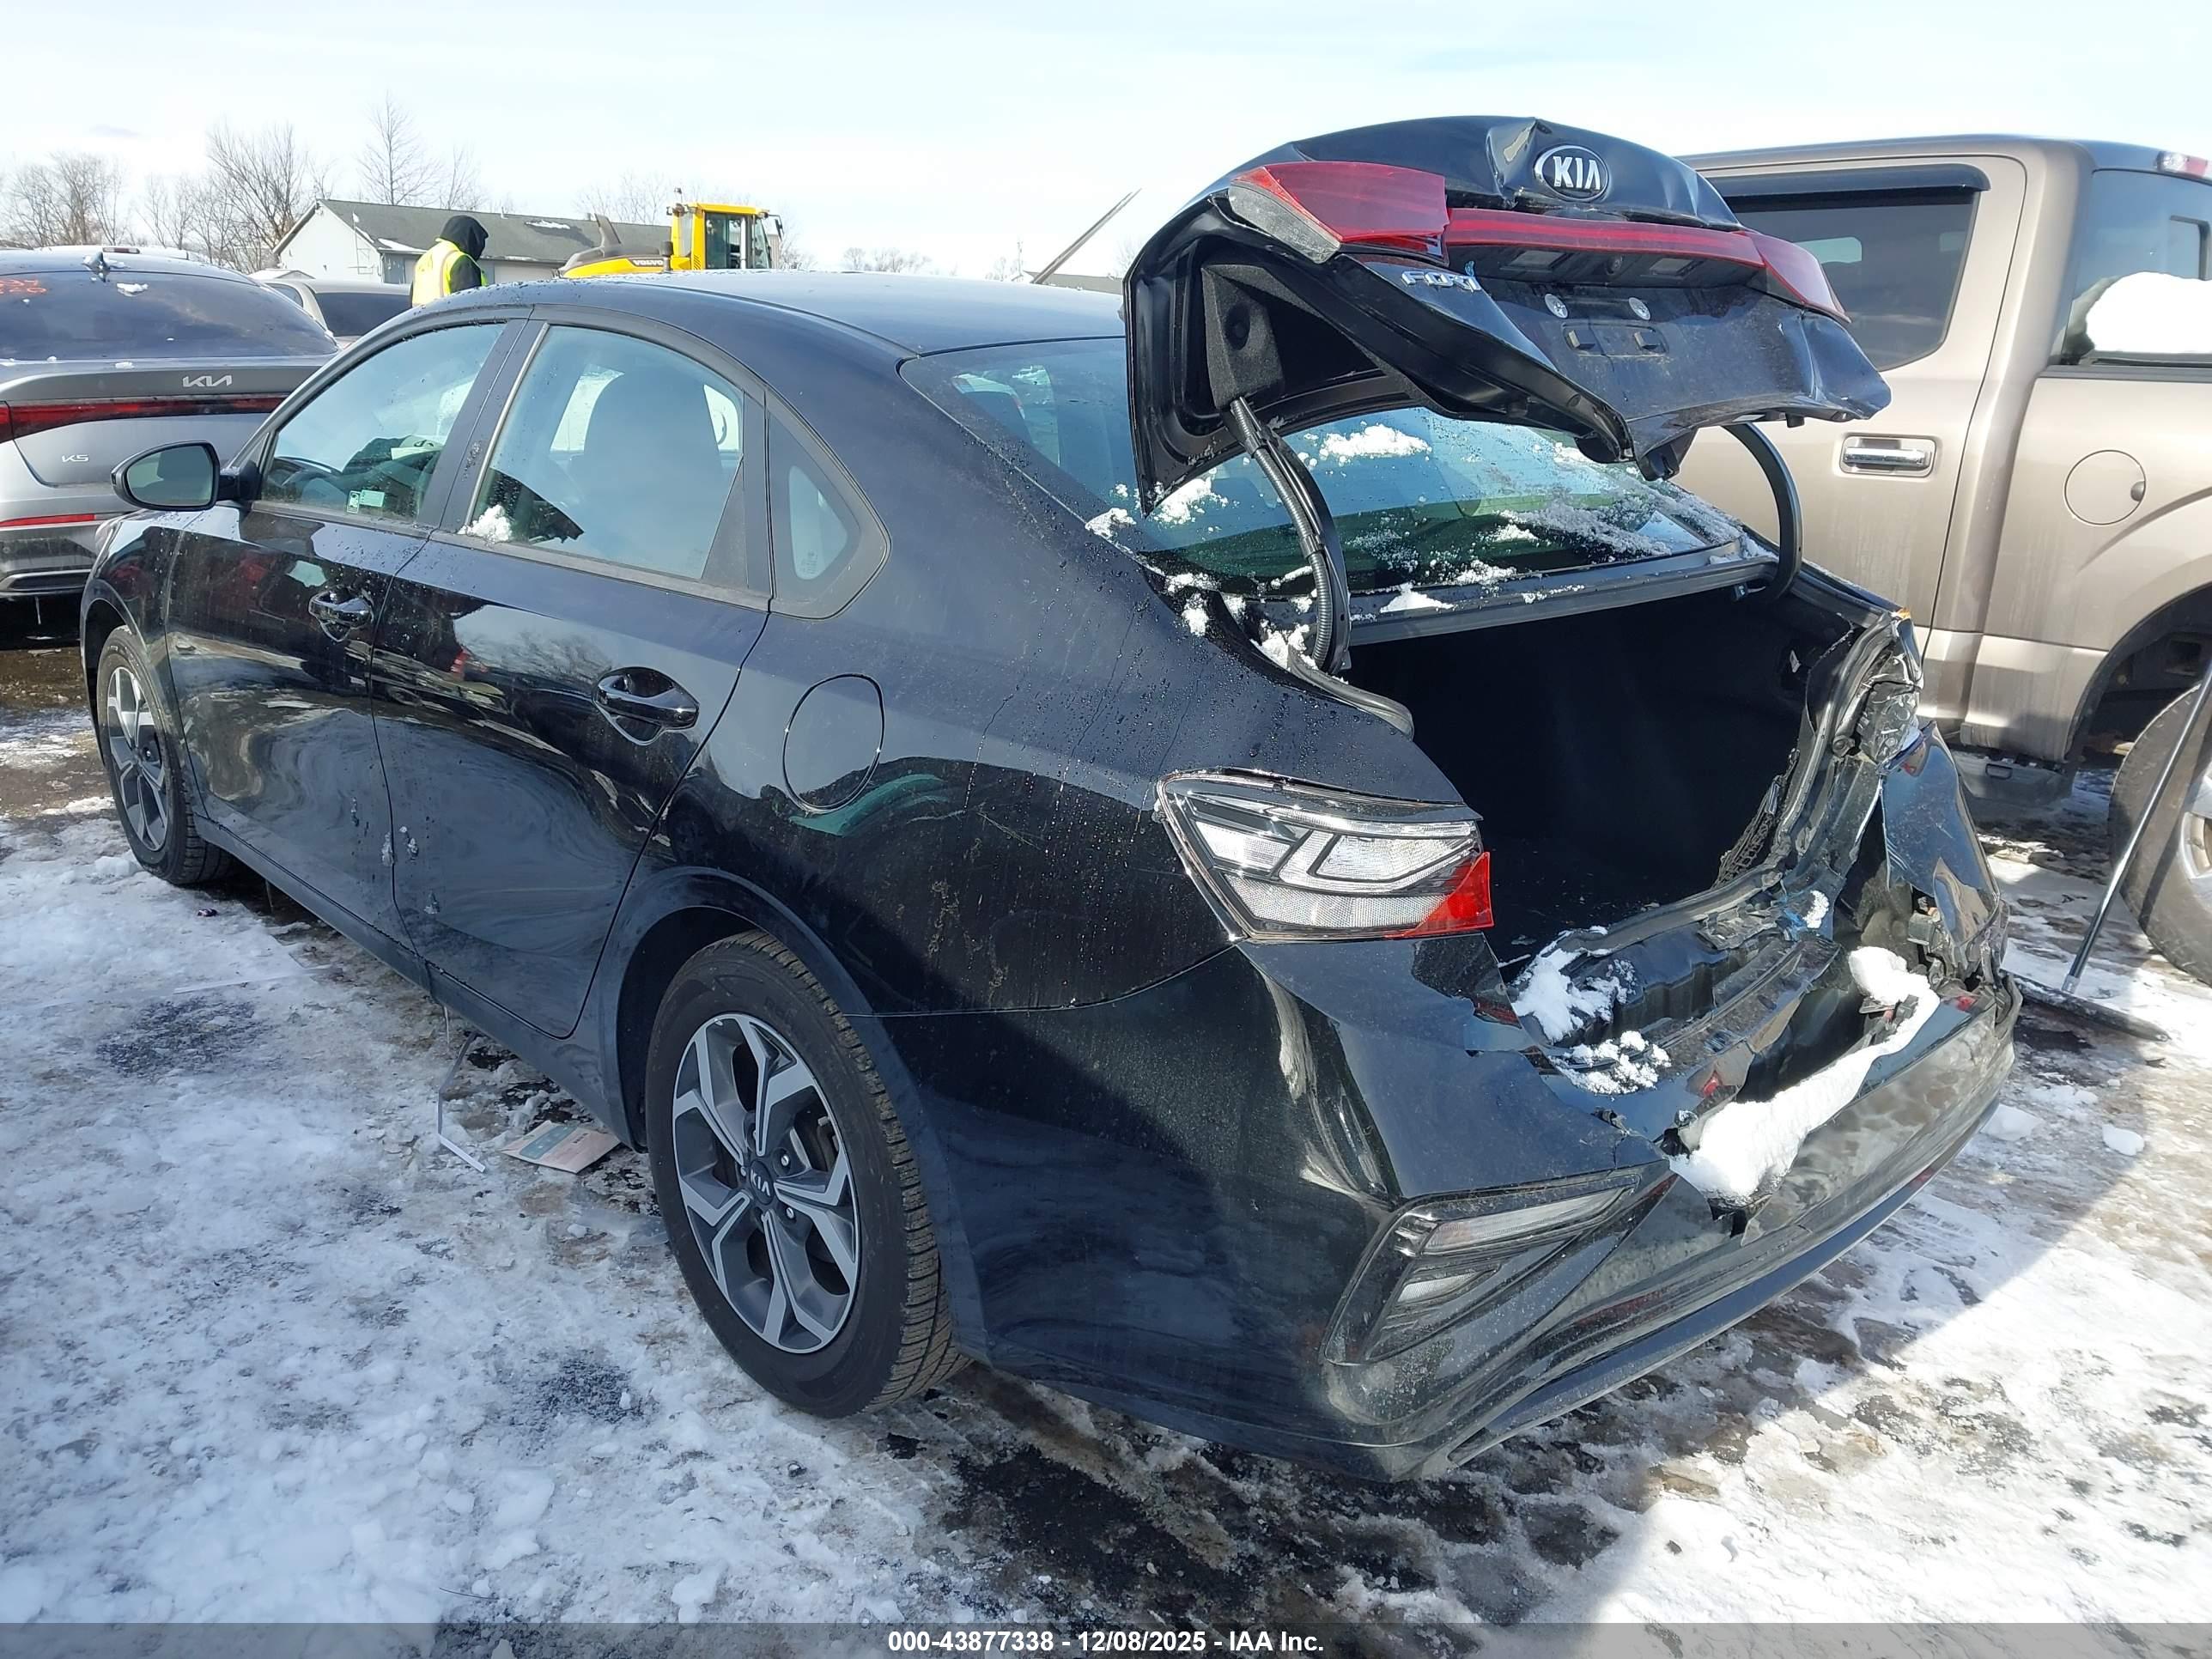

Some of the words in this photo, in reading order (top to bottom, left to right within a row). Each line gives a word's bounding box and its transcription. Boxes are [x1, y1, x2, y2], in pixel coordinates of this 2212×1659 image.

[1553, 155, 1601, 190] KIA
[182, 374, 233, 387] KIA
[750, 1169, 771, 1196] KIA
